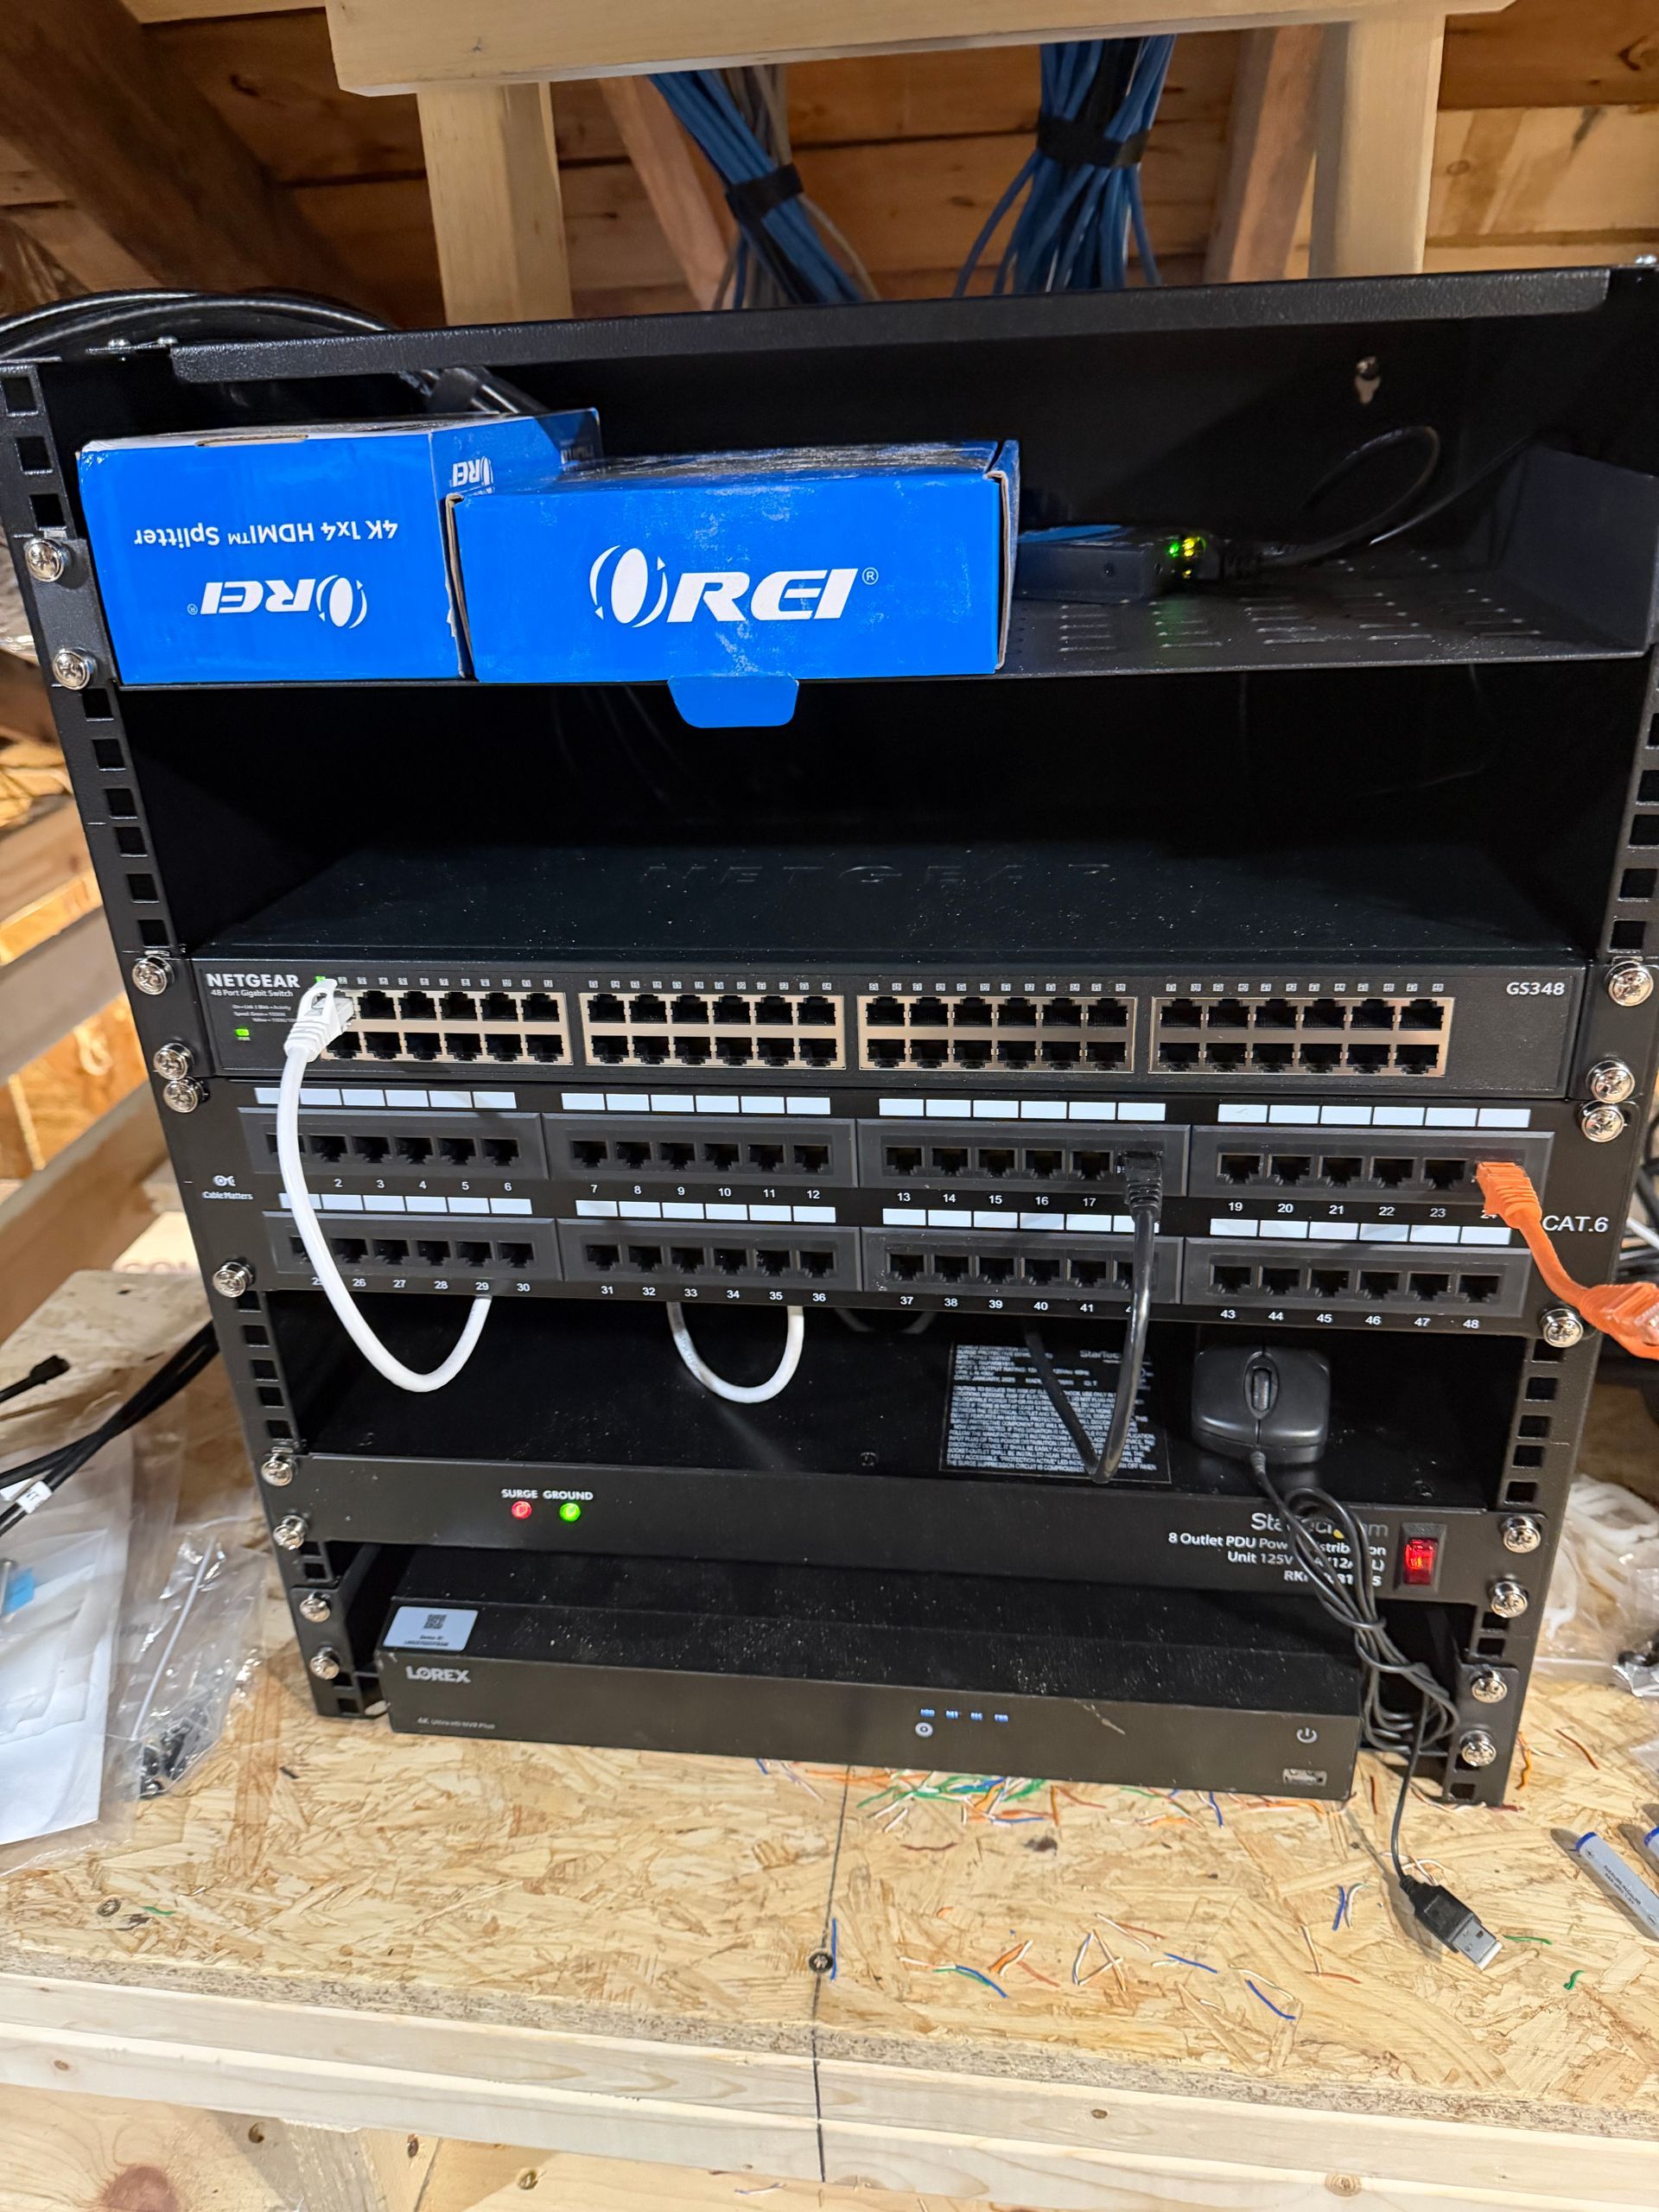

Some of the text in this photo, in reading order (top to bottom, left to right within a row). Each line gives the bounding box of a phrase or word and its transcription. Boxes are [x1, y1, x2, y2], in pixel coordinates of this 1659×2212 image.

[134, 525, 219, 548] Splitter
[321, 521, 360, 542] 1x4
[366, 519, 398, 540] 4K
[206, 973, 301, 988] NETGEAR
[240, 990, 269, 999] Gigabit
[1506, 982, 1566, 996] GS348
[334, 1178, 512, 1192] 2 3 4 5 6
[590, 1184, 820, 1199] 7 8 9 10 11 12
[897, 1192, 1096, 1207] 13 14 15 16 17
[1229, 1202, 1243, 1211] 19
[1277, 1203, 1294, 1213] 20
[1328, 1205, 1344, 1215] 21
[1378, 1206, 1395, 1217] 22
[1429, 1207, 1446, 1218] 23
[1541, 1215, 1610, 1233] CAT.6
[352, 1278, 366, 1287] 26
[393, 1279, 406, 1288] 27
[434, 1281, 448, 1290] 28
[475, 1281, 489, 1291] 29
[517, 1282, 531, 1292] 30
[601, 1285, 826, 1302] 31 32 33 34 35 36
[899, 1295, 1093, 1313] 37 38 39 40 41
[1220, 1309, 1479, 1329] 43 44 45 46 47 48
[501, 1489, 594, 1500] SURGE GROUND
[1168, 1532, 1178, 1543] 8
[1179, 1533, 1224, 1547] Outlet
[1225, 1535, 1257, 1548] PDU
[1227, 1550, 1258, 1563] Unit
[1260, 1553, 1294, 1565] 125V
[405, 1665, 471, 1684] LOREX
